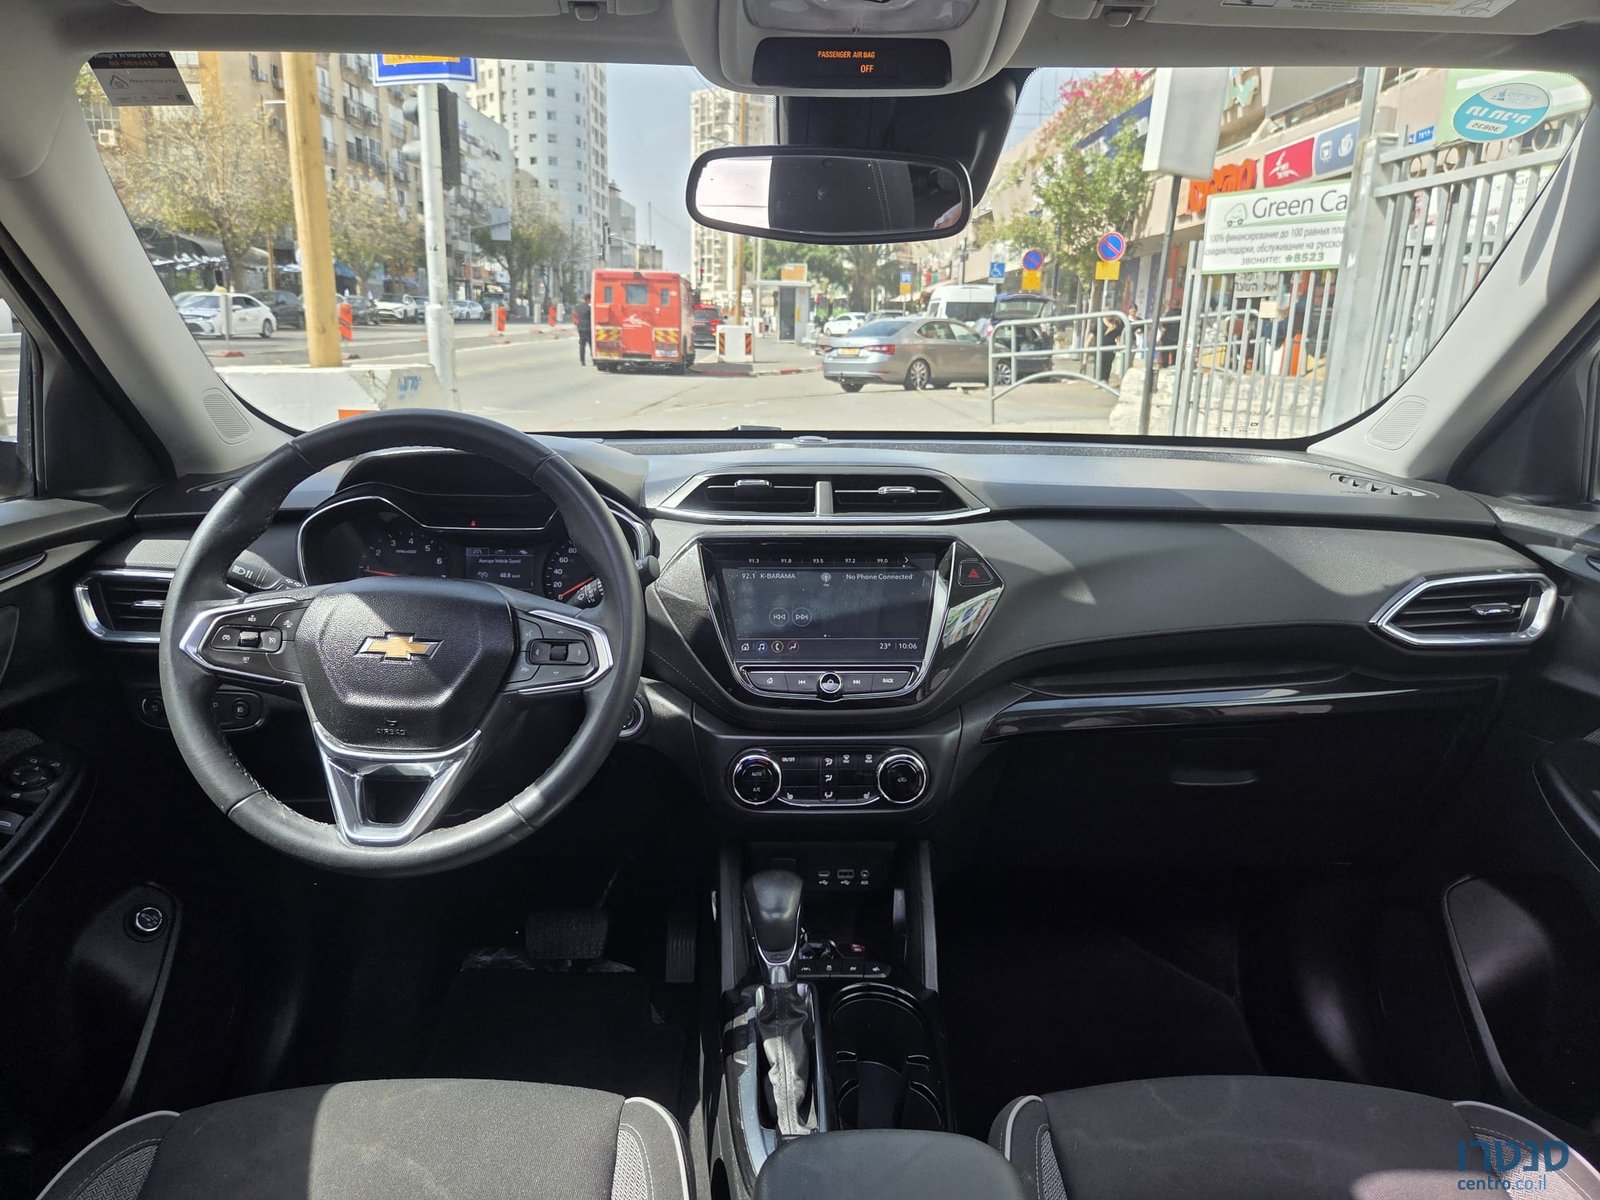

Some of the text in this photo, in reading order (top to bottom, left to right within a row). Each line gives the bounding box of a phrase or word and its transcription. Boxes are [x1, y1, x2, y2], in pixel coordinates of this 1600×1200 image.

[817, 50, 851, 58] PASSENGER
[860, 64, 874, 73] OFF
[1252, 196, 1314, 219] Green
[1291, 228, 1303, 237] 100
[879, 641, 917, 649] 23° 10:06
